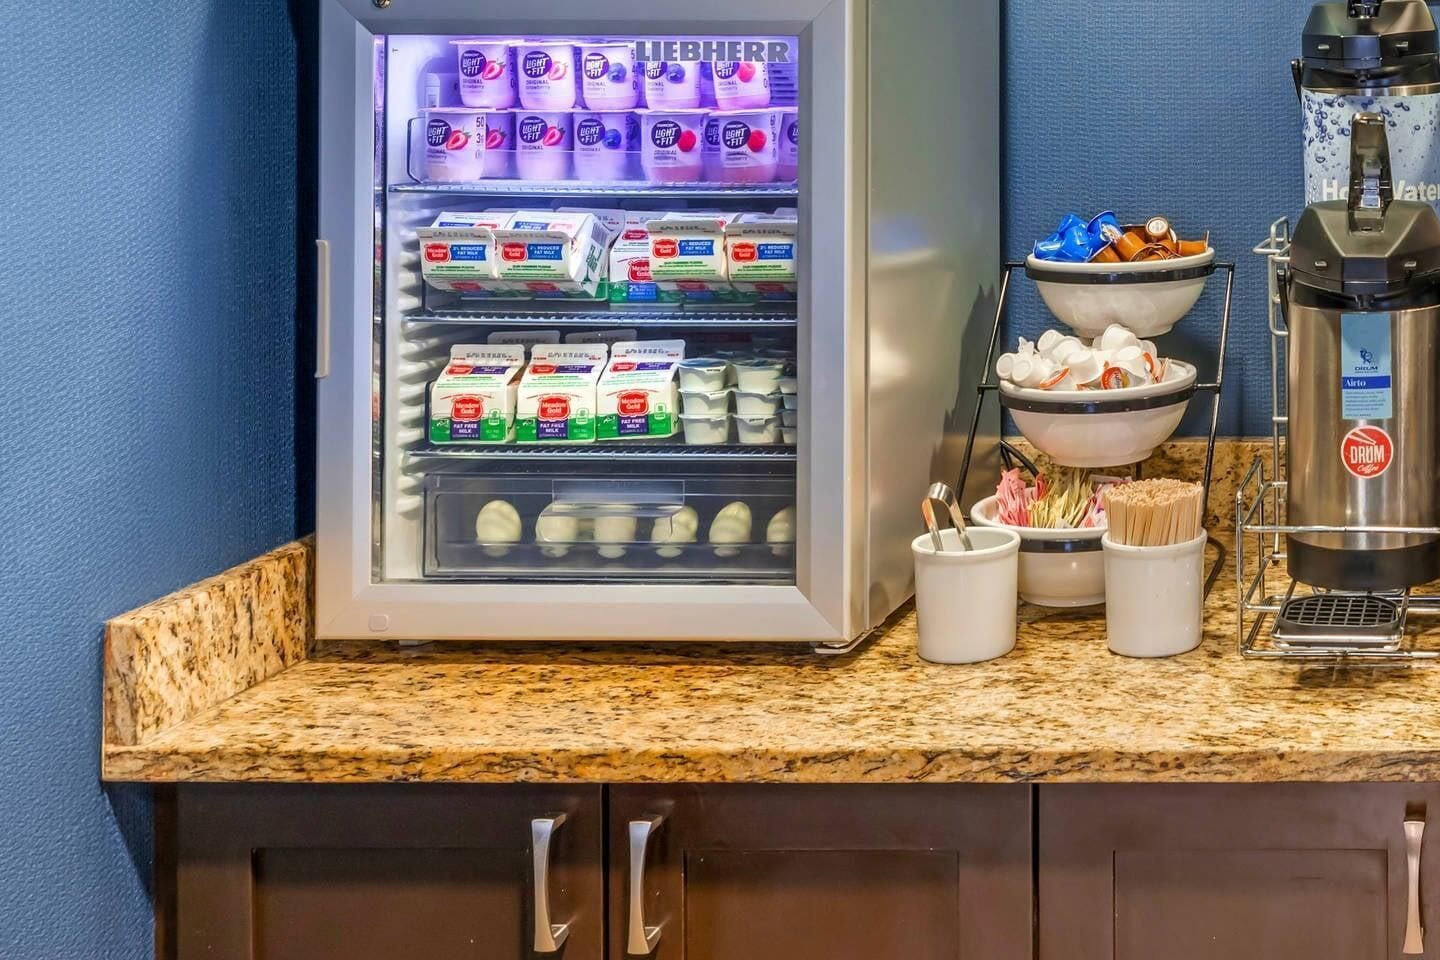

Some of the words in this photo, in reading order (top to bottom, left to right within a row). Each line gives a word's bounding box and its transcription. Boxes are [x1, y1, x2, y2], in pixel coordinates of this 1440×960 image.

[635, 40, 790, 62] LIEBHERR
[1322, 179, 1349, 201] Ho
[1344, 379, 1367, 387] Airto
[1350, 444, 1385, 464] DRUM
